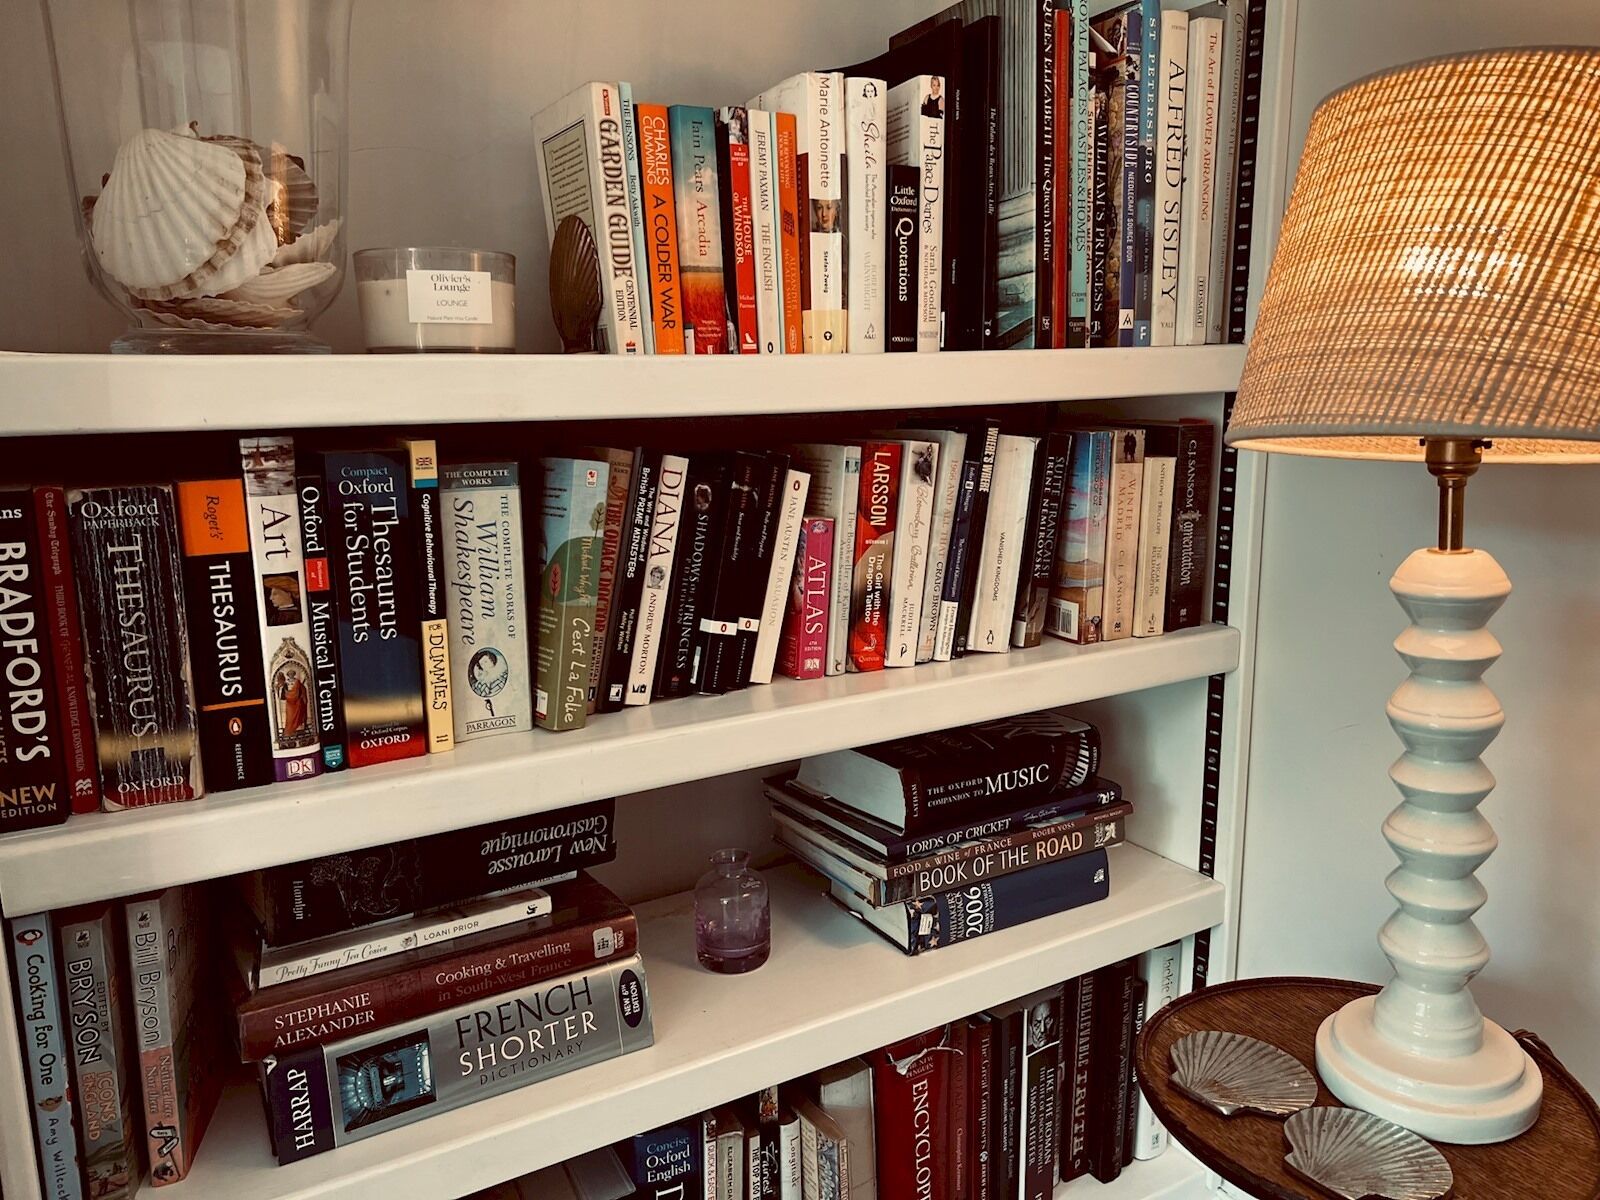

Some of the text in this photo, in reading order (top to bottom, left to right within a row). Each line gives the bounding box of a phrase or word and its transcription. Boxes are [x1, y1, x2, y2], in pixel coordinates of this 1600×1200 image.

[1124, 84, 1138, 169] COUNTRYSIDE
[1144, 17, 1156, 184] ST PETERSBURG
[642, 115, 656, 185] CUMMING
[652, 116, 669, 186] CHARLES
[819, 76, 831, 188] Marie Antoinette
[861, 120, 880, 169] Sheila
[1042, 0, 1054, 263] QUEEN ELIZABETH The Queen Mother
[690, 120, 708, 257] Iain Pears Arcadia
[894, 185, 915, 196] Little
[923, 143, 942, 184] Palace
[1127, 171, 1135, 216] NEEDLECRAFT
[1160, 58, 1185, 302] ALFRED SISLEY
[599, 118, 633, 280] GARDEN GUIDE
[733, 192, 744, 265] OF WINDSOR
[755, 130, 773, 292] JEREMY PAXMAN THE ENGLISH
[891, 195, 918, 207] Oxford
[923, 186, 939, 234] Diaries
[1093, 124, 1108, 312] WILLIAM'S PRINCESS
[652, 195, 676, 330] A COLDER WAR
[742, 214, 752, 256] HOUSE
[894, 217, 914, 302] Quotations
[431, 273, 471, 282] Olivier's
[433, 283, 470, 292] Lounge
[615, 289, 626, 322] EDITION
[625, 279, 638, 330] CENTENNIAL
[928, 276, 936, 323] Goodall
[338, 478, 394, 495] Oxford
[341, 466, 389, 479] Compact
[445, 469, 510, 479] THE COMPLETE
[461, 477, 492, 486] WORKS
[870, 452, 892, 527] LARSSON
[978, 428, 999, 492] WHERE'S WHERE
[80, 497, 161, 520] Oxford
[83, 517, 161, 530] PAPERBACK
[203, 495, 225, 542] Roget's
[260, 503, 293, 562] Art
[301, 486, 324, 554] Oxford
[650, 468, 682, 559] DIANA
[1033, 456, 1055, 579] IRENE NEMIROVSKY
[344, 501, 374, 644] for Students
[371, 496, 398, 641] Thesaurus
[450, 498, 477, 646] Shakespeare
[476, 520, 500, 620] William
[500, 494, 516, 638] THE COMPLETE WORKS OF
[676, 514, 708, 670] SHADOWS PRINCESS
[804, 555, 826, 634] ATLAS
[864, 556, 876, 624] Dragon Tattoo
[872, 552, 886, 626] The Girl with the
[930, 562, 944, 631] CRAIG BROWN
[0, 541, 51, 763] BRADFORD'S
[107, 533, 159, 739] THESAURUS
[208, 561, 243, 697] THESAURUS
[638, 592, 657, 675] ANDREW MORTON
[311, 602, 336, 732] Musical Terms
[428, 634, 448, 711] DUMMIES
[564, 616, 591, 724] C'est La Folie
[360, 732, 410, 750] OXFORD
[466, 717, 517, 733] PARRAGON
[0, 783, 56, 808] NEW
[117, 775, 184, 794] OXFORD
[928, 778, 983, 796] THE OXFORD
[928, 789, 984, 808] COMPANION TO
[985, 764, 1050, 796] MUSIC
[1, 803, 57, 819] EDITION
[480, 814, 608, 855] Gastronomique
[906, 818, 1012, 856] LORDS OF CRICKET
[487, 834, 608, 875] New Larousse
[920, 832, 1084, 892] BOOK OF THE ROAD
[292, 880, 306, 920] Hamlyn
[945, 892, 957, 942] WHITAKER'S
[962, 886, 984, 938] 2006
[422, 920, 480, 941] LOANI PRIOR
[134, 930, 162, 1046] Bill Bryson
[435, 940, 572, 985] Cooking & Travelling
[26, 954, 57, 1087] Cooking for One
[67, 956, 102, 1067] BRYSON
[274, 992, 372, 1030] STEPHANIE
[454, 976, 594, 1049] FRENCH
[630, 980, 640, 1014] EDITION
[274, 1009, 376, 1049] ALEXANDER
[459, 1010, 598, 1078] SHORTER
[480, 1040, 584, 1086] DICTIONARY
[1073, 976, 1093, 1156] UNBELIEVABLE TRUTH
[82, 1072, 101, 1142] ENGLAND
[286, 1068, 316, 1152] HARRAP
[1044, 1068, 1054, 1164] LIKE THE ROMAN
[646, 1136, 689, 1154] Concise
[646, 1144, 690, 1169] Oxford
[646, 1160, 690, 1183] English
[789, 1136, 799, 1188] Longitude
[1028, 1126, 1036, 1167] HEFFER
